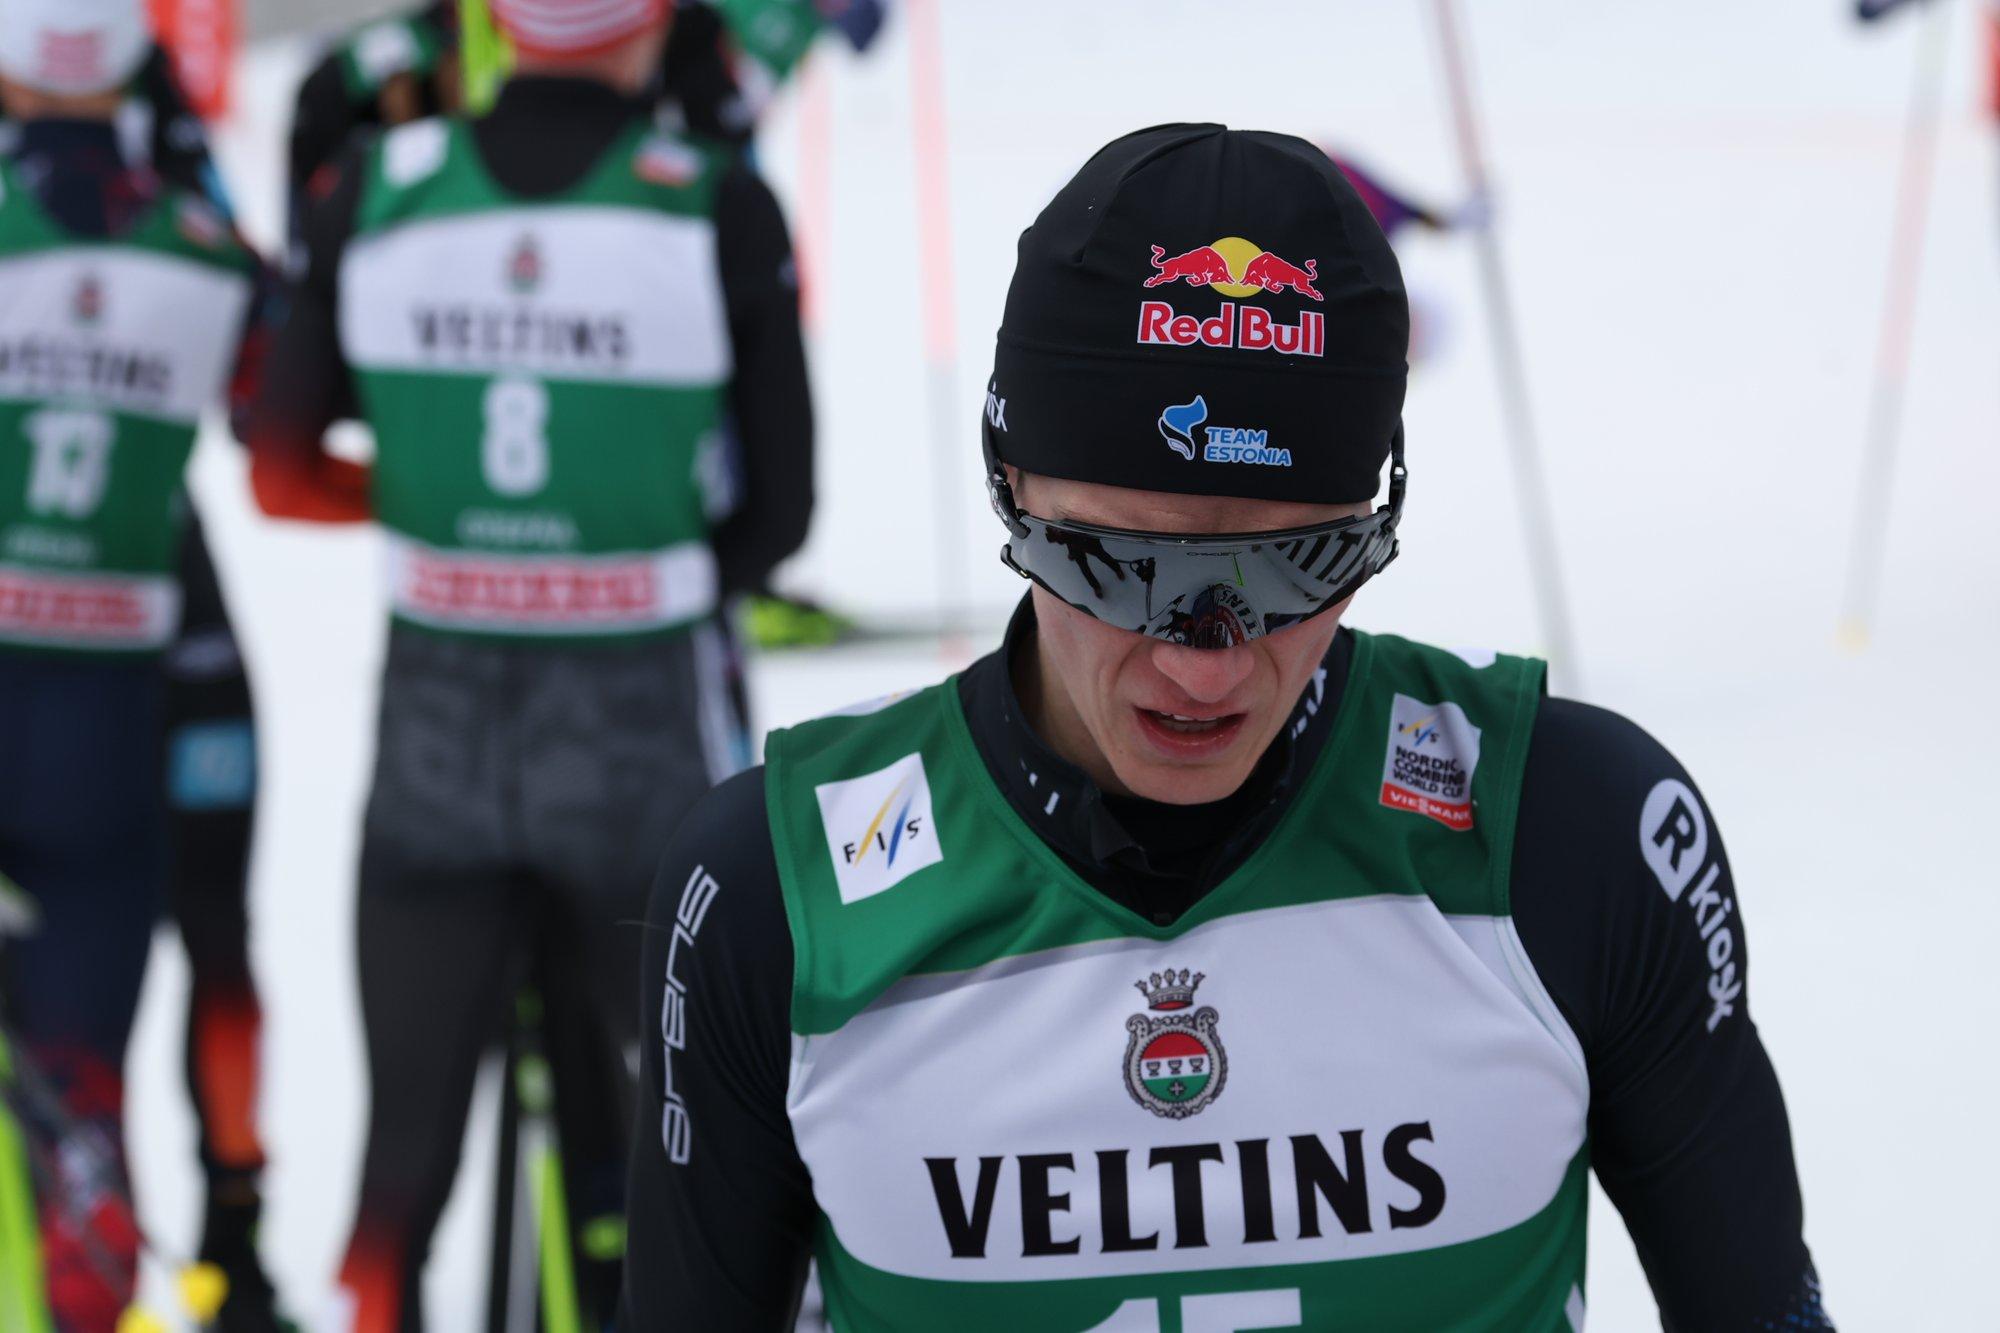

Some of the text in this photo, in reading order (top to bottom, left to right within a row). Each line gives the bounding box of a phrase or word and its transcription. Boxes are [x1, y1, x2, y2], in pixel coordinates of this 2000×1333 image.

[1138, 302, 1324, 356] Red Bull
[483, 375, 548, 496] 8
[1206, 428, 1267, 447] TEAM
[1205, 446, 1292, 467] ESTONIA
[1394, 757, 1467, 786] COMBIN
[1395, 745, 1459, 773] NORDIC
[1393, 768, 1438, 794] WORLD
[843, 817, 922, 864] FIS
[1652, 795, 1743, 1034] R kiosk
[922, 1120, 1447, 1259] VELTINS
